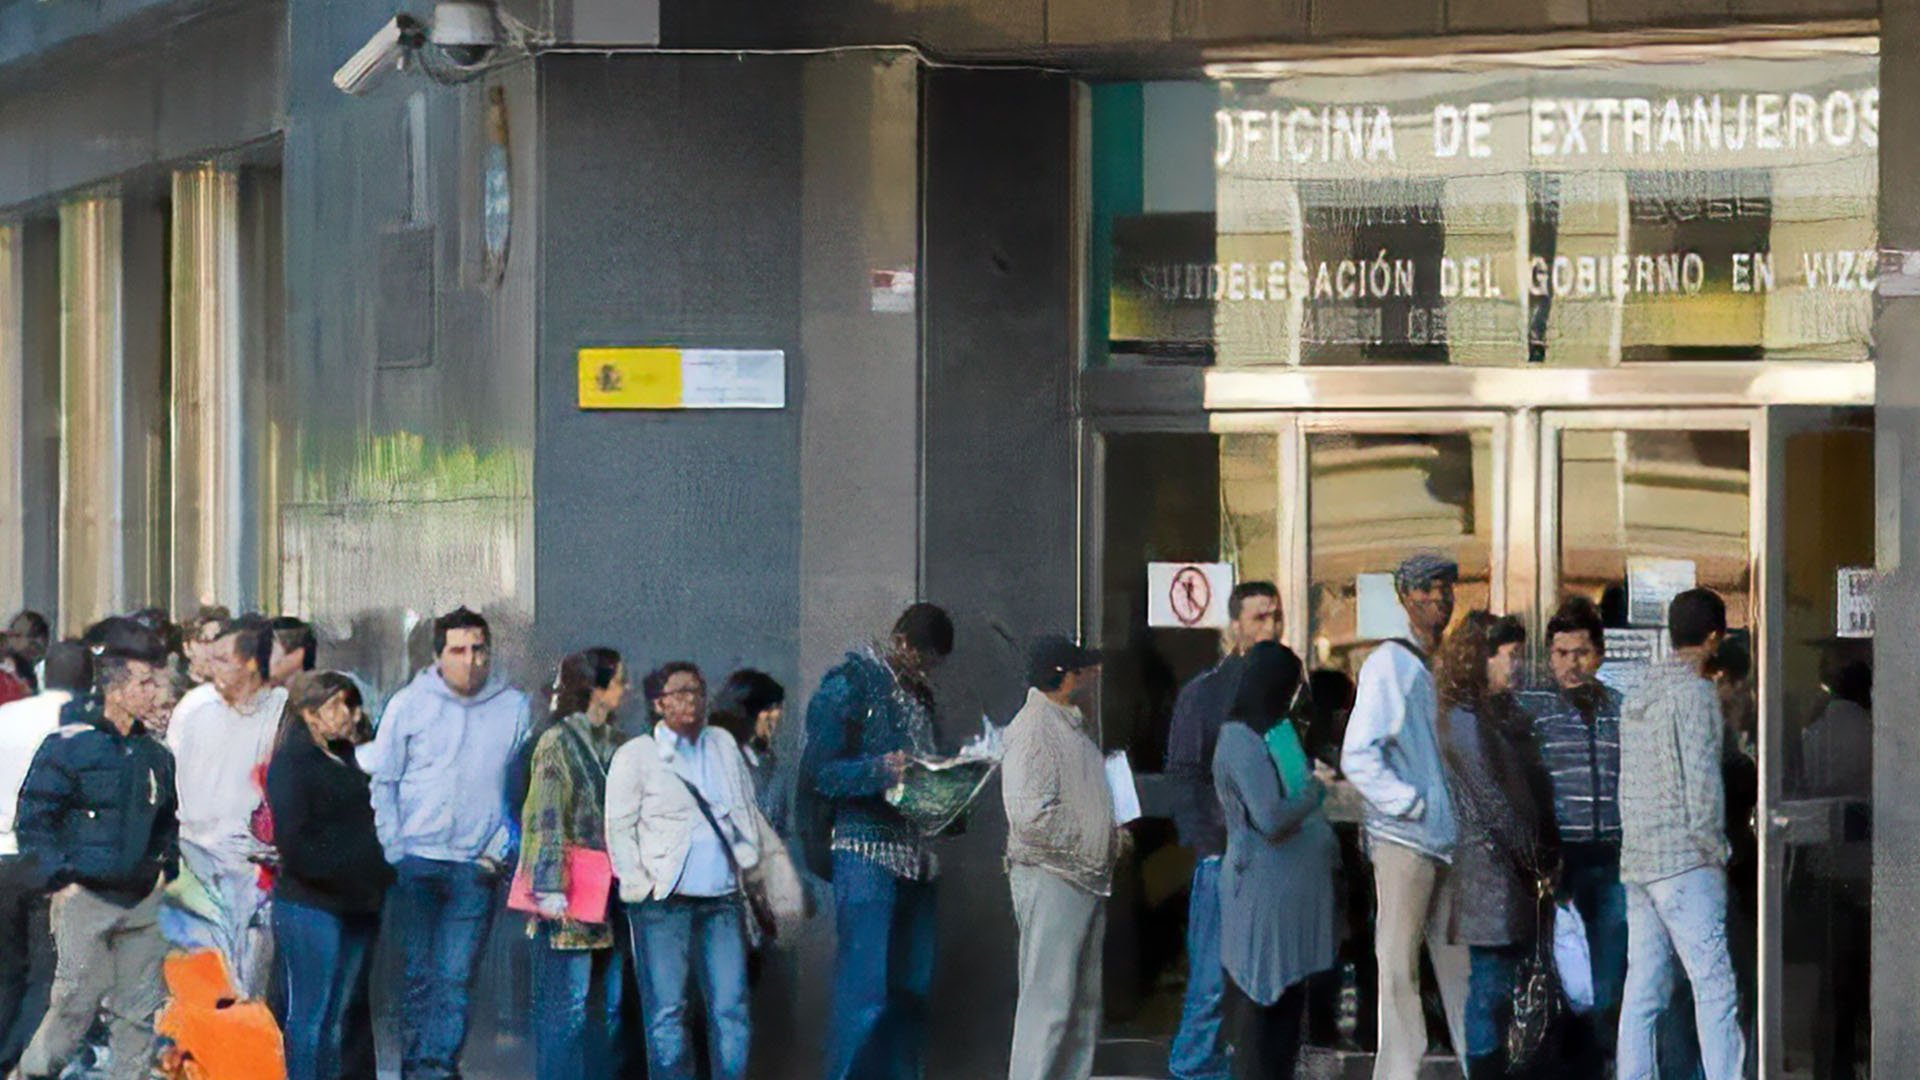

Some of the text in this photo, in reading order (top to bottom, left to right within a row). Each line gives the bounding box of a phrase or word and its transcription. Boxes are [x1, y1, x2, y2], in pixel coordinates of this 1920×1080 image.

[1433, 103, 1493, 158] DE
[1531, 89, 1878, 156] EXTRANJEROS
[1439, 254, 1501, 299] DEL
[1527, 251, 1705, 299] GOBIERNO
[1732, 251, 1776, 293] EN
